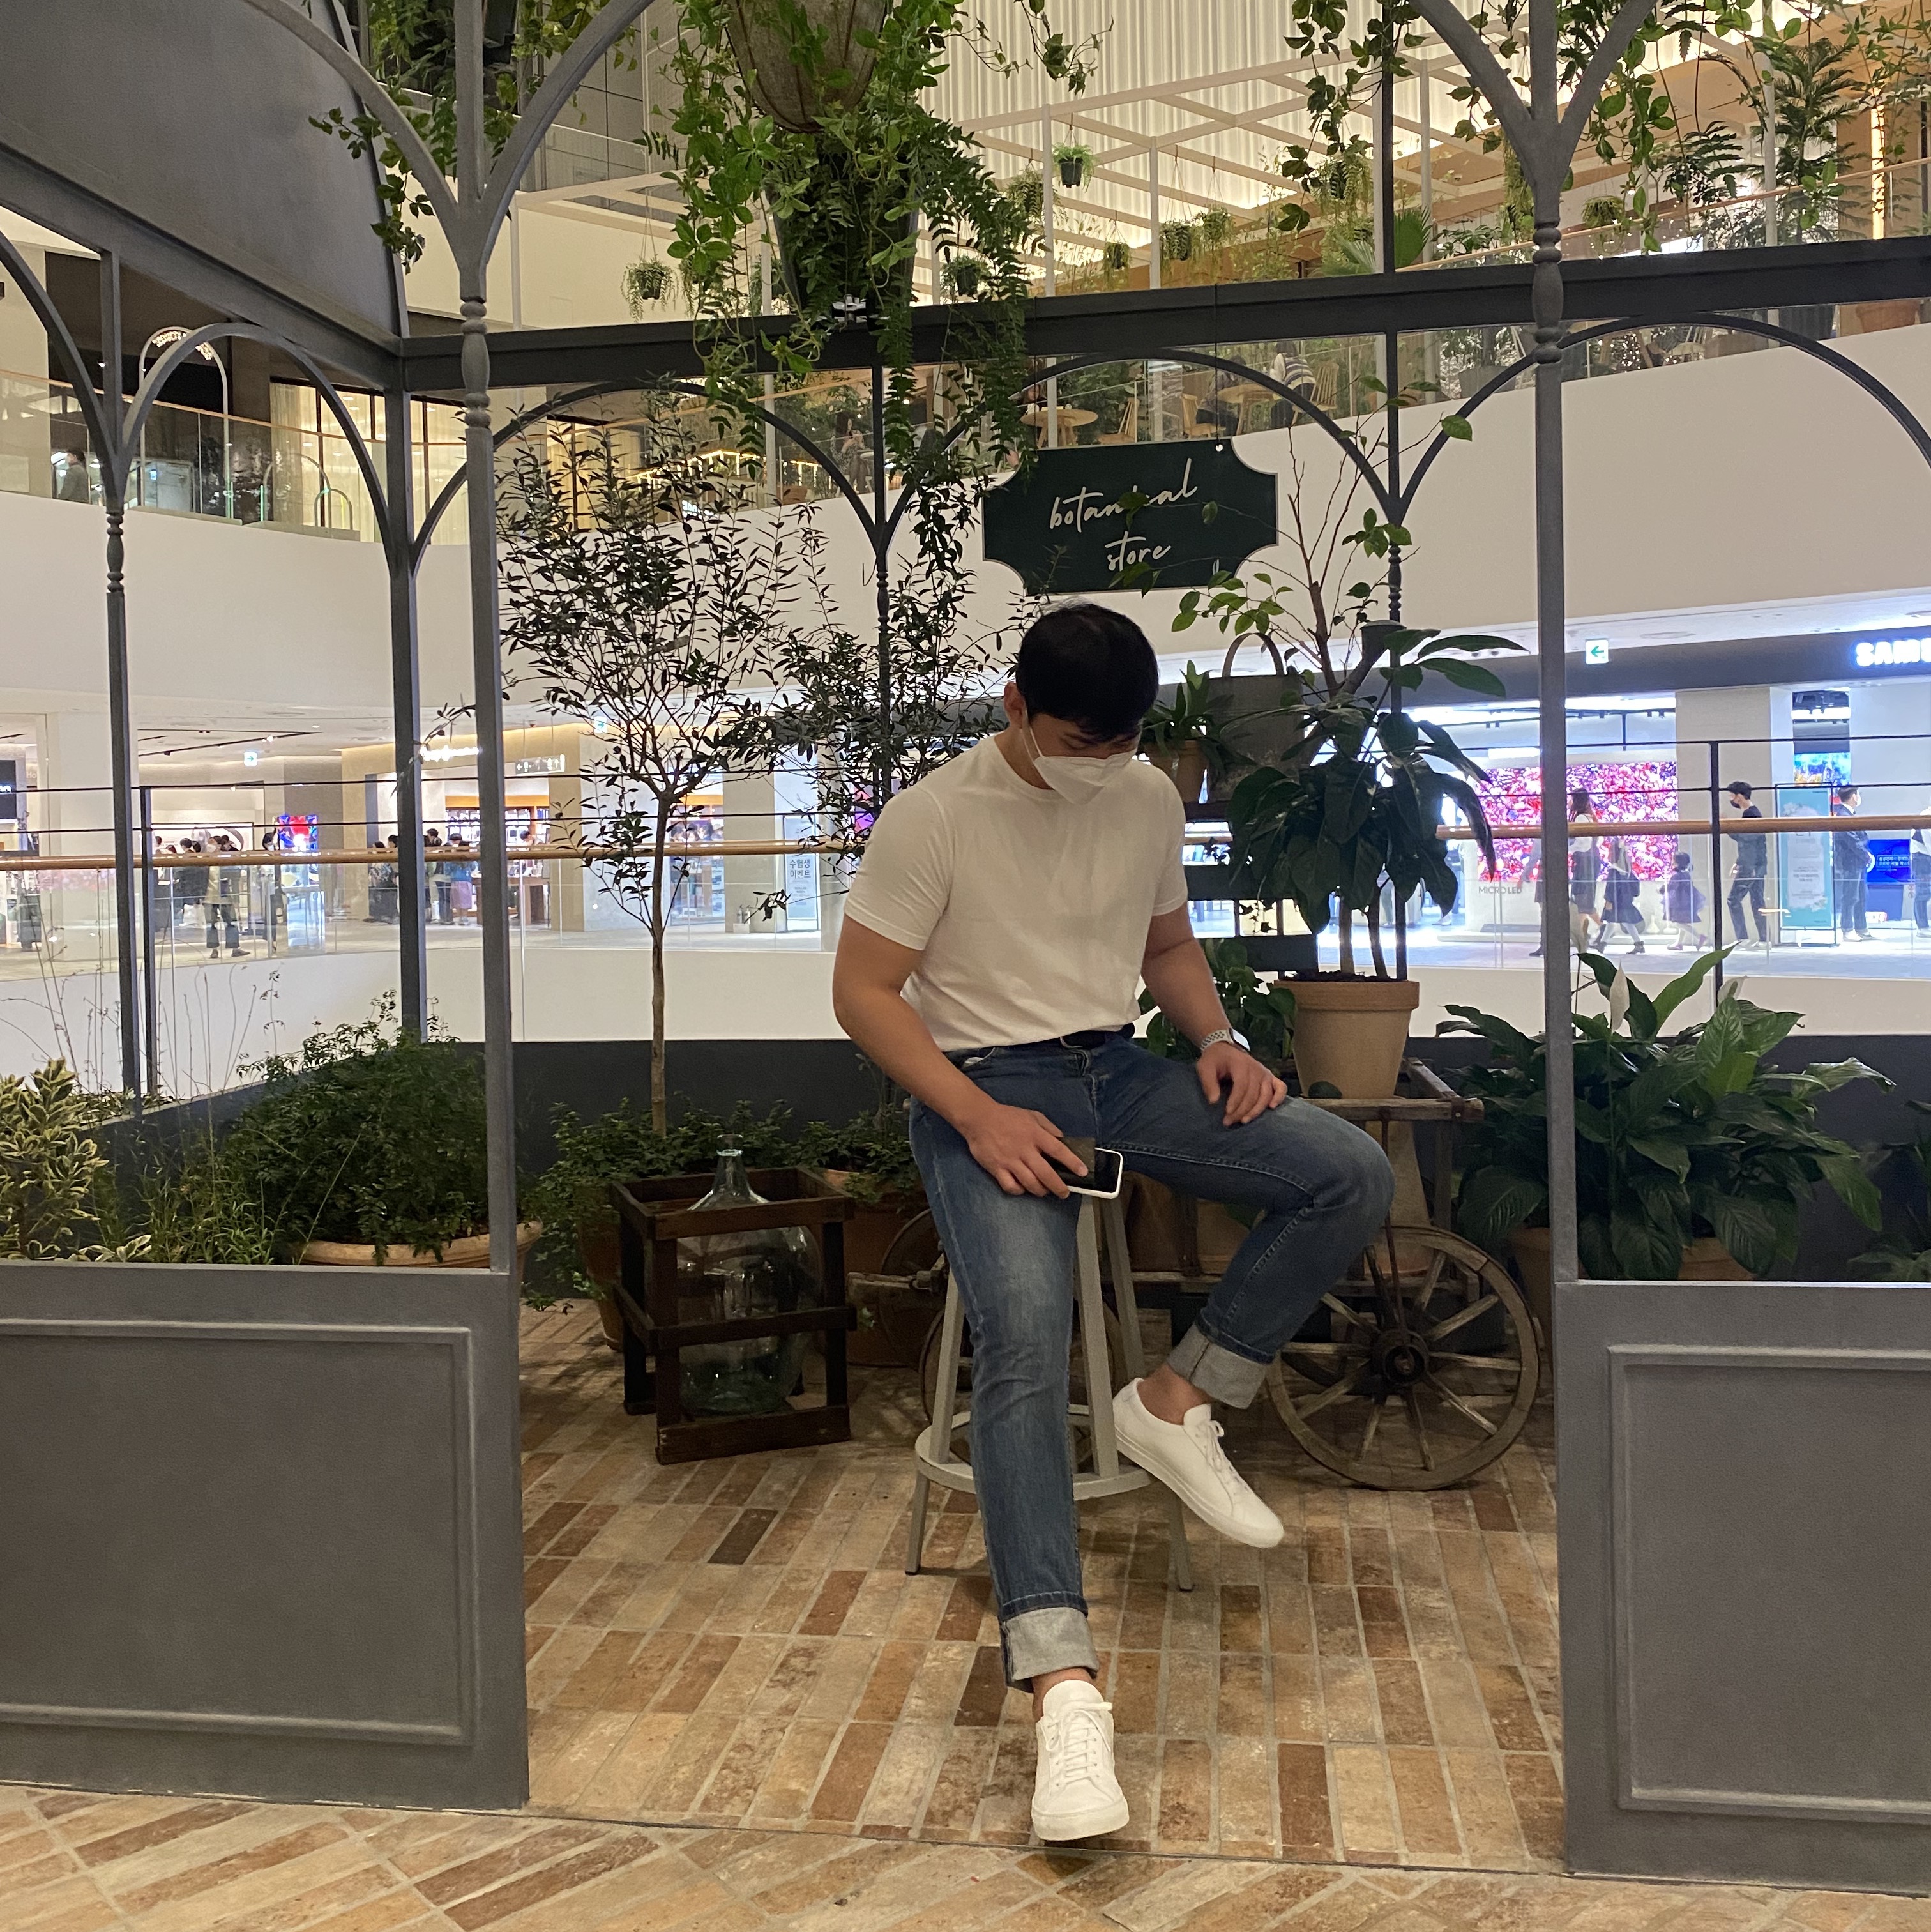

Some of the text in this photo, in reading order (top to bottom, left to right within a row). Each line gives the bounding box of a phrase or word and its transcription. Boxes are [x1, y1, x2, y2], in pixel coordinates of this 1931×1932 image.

[1049, 457, 1198, 533] botanal
[1105, 531, 1172, 572] store
[789, 859, 810, 869] 수험생
[790, 869, 811, 879] 이벤트
